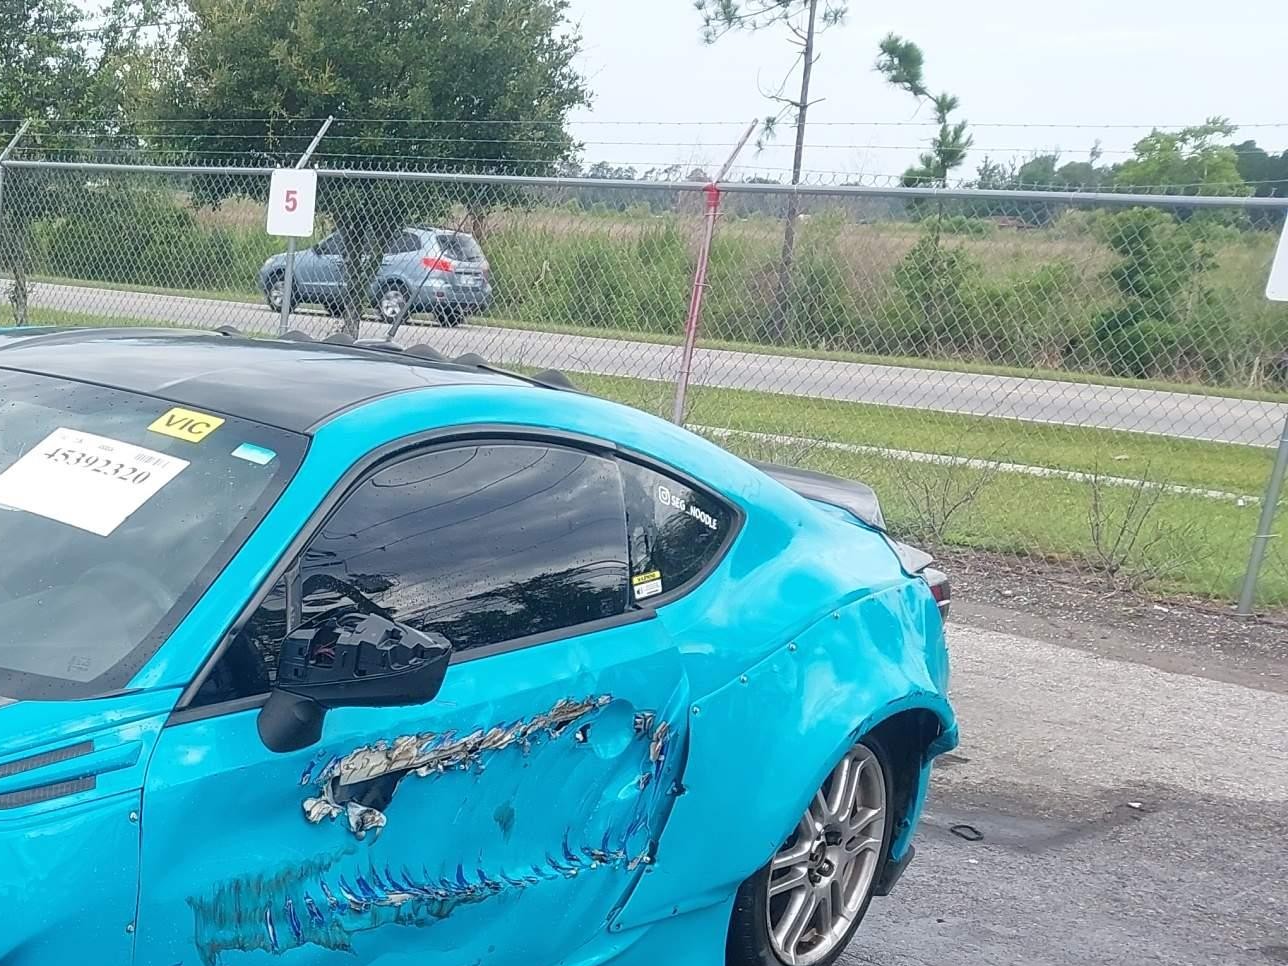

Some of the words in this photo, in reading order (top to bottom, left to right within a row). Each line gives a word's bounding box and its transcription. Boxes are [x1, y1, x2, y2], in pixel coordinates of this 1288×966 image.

[284, 189, 298, 213] 5
[163, 413, 211, 435] VIC
[43, 446, 151, 486] 45392320
